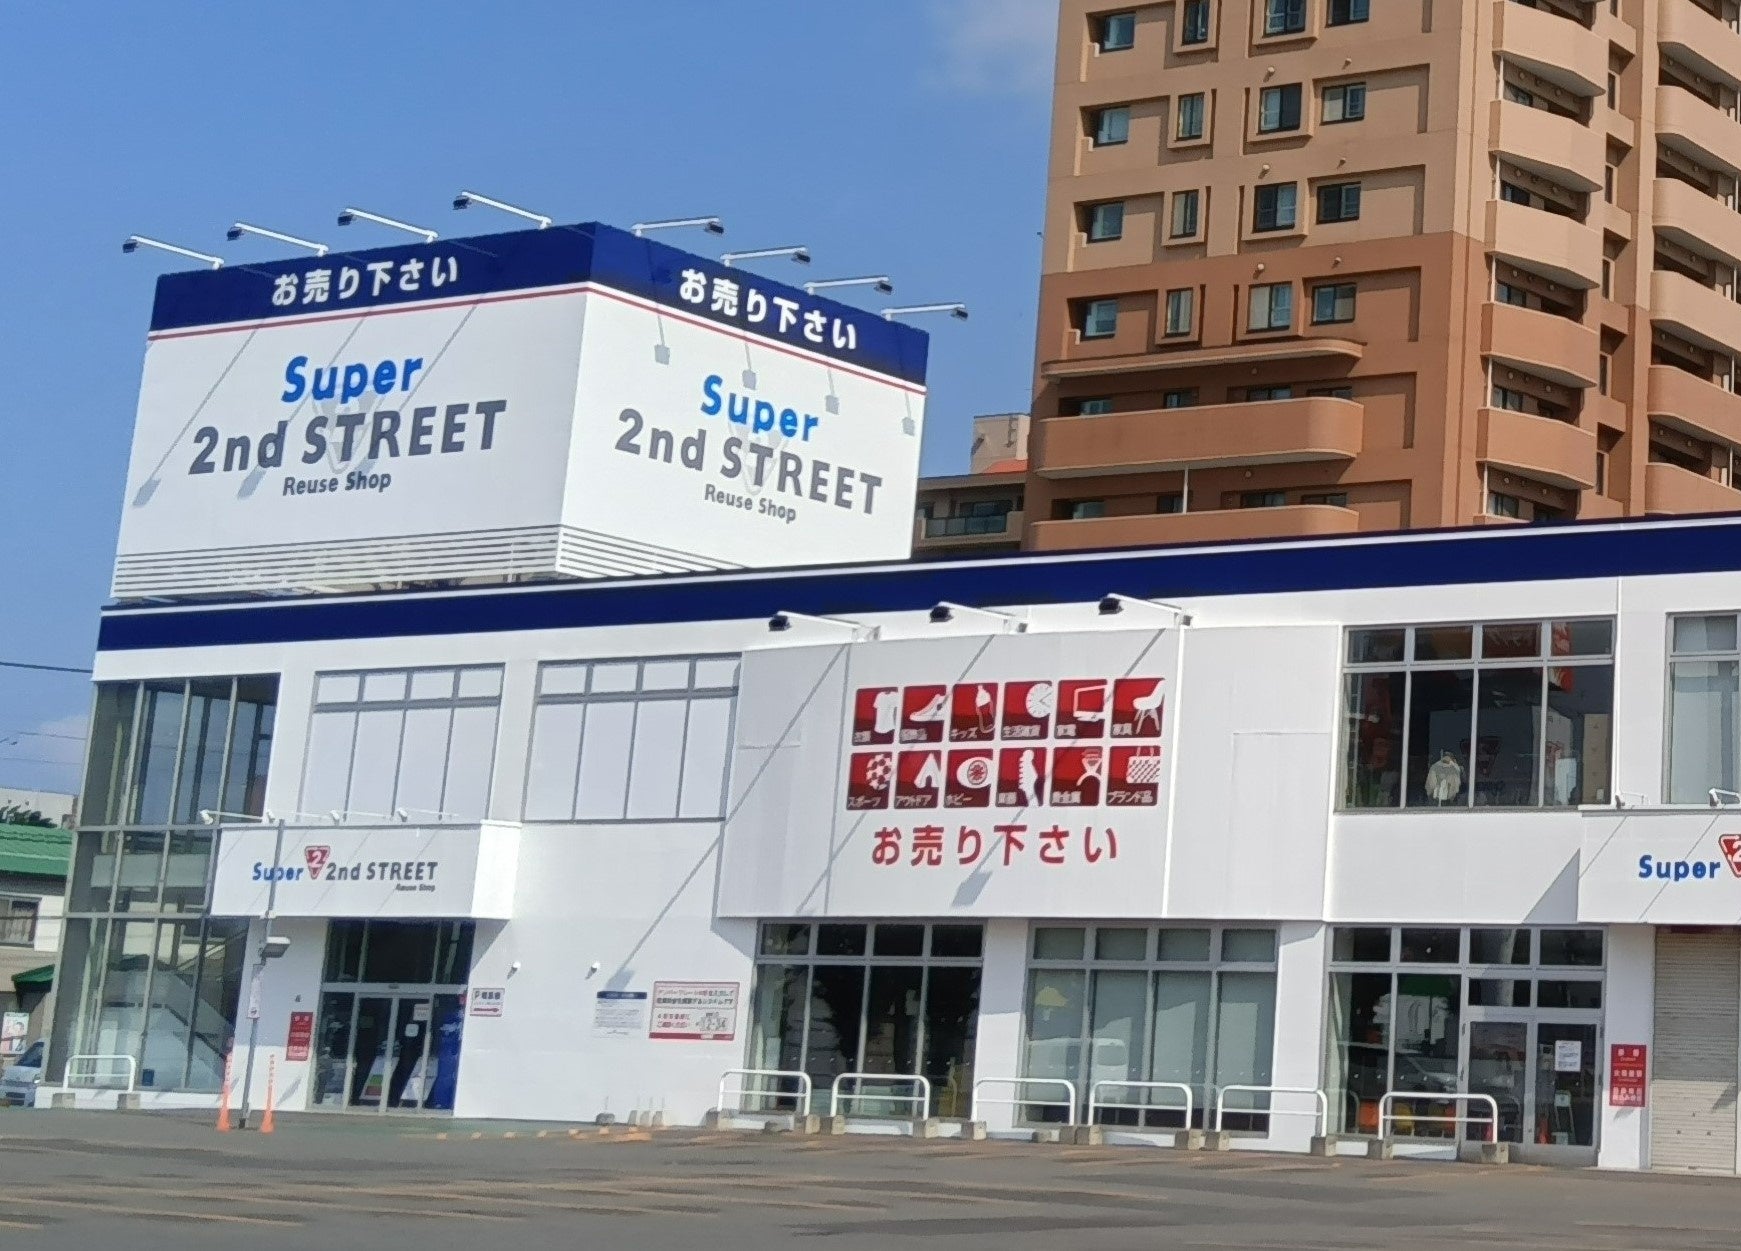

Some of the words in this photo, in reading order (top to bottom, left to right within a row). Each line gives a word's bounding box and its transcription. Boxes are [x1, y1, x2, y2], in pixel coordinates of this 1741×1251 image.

[272, 256, 458, 306] お売り下さい
[680, 269, 857, 349] お売り下さい
[281, 355, 424, 404] Super
[700, 374, 819, 442] Super
[188, 420, 288, 475] 2nd
[302, 400, 507, 464] STREET
[615, 408, 706, 471] 2nd
[720, 436, 883, 515] STREET
[282, 475, 339, 497] Reuse
[345, 470, 392, 494] Shop
[704, 483, 753, 511] Reuse
[758, 498, 797, 524] Shop
[871, 824, 1118, 866] お売り下さい
[1638, 854, 1721, 882] Super
[325, 862, 361, 880] 2nd
[366, 862, 438, 880] STREET
